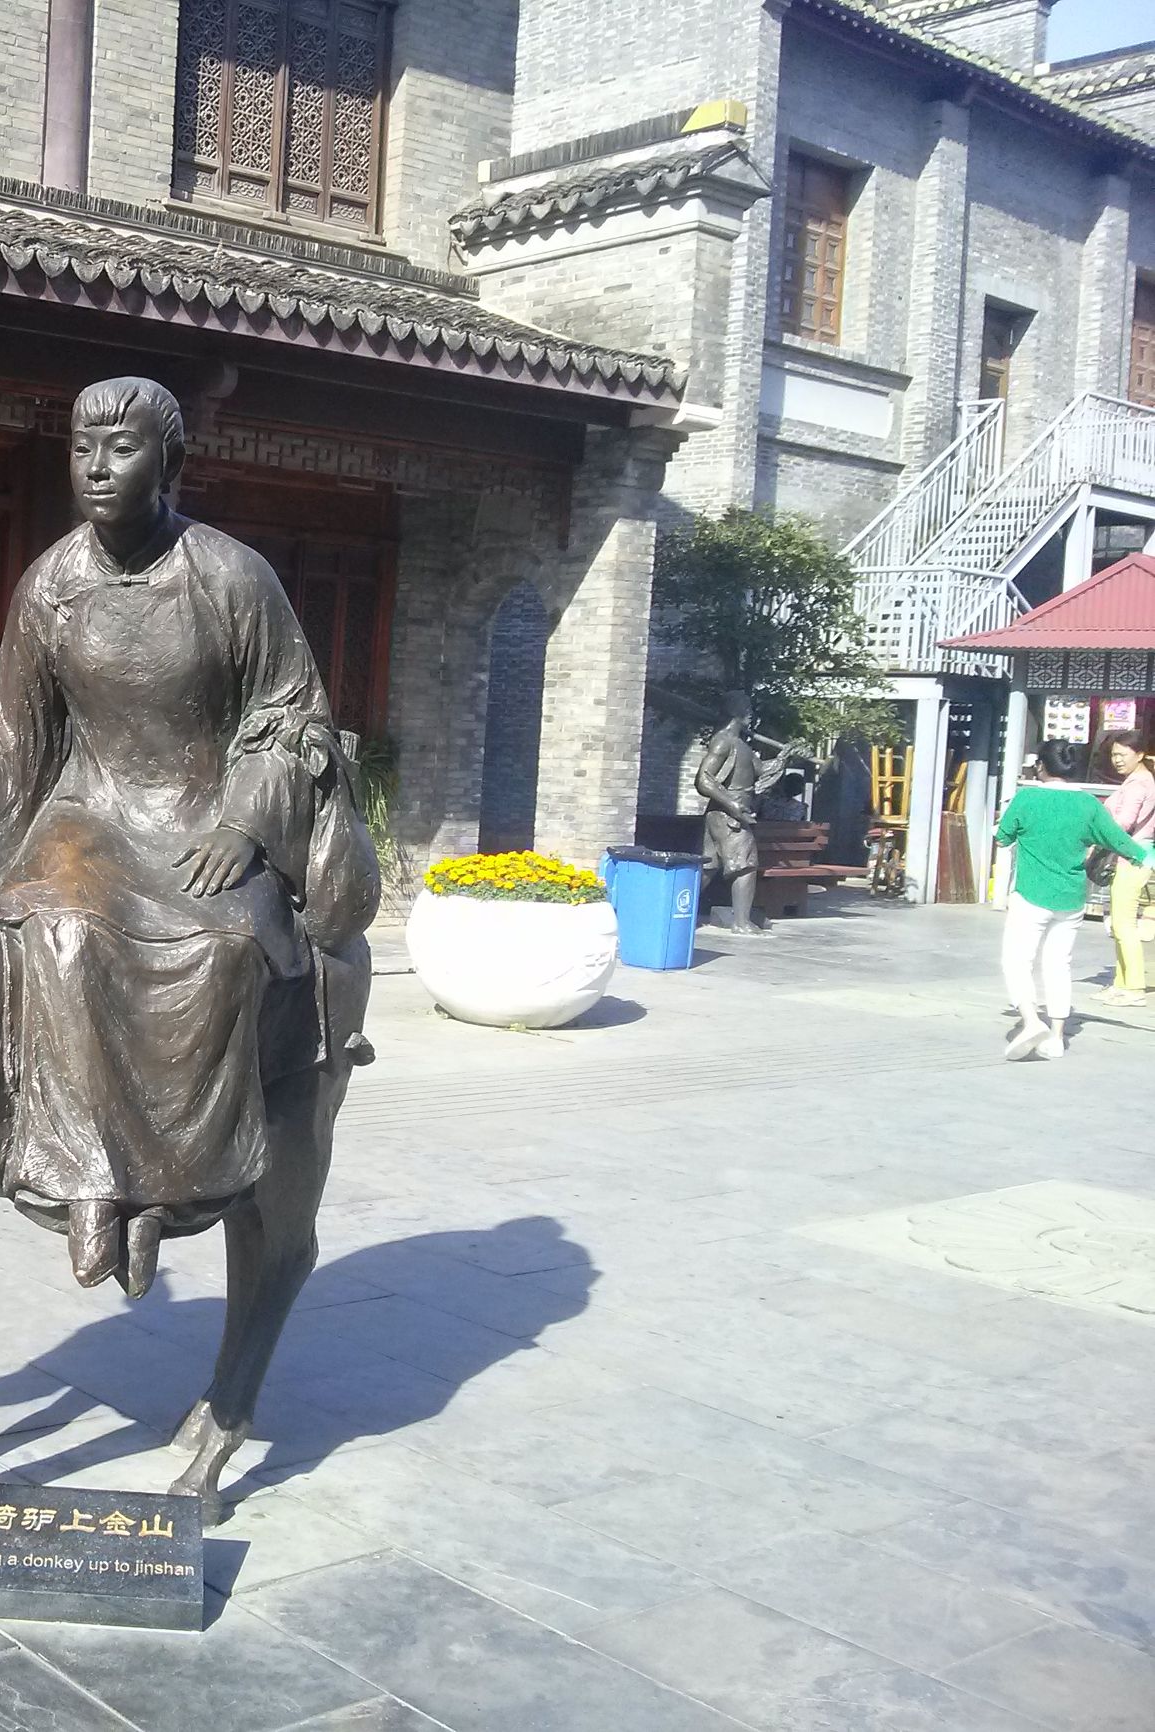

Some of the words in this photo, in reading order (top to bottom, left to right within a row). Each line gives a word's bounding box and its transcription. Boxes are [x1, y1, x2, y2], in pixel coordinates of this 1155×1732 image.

[7, 1554, 18, 1566] a
[23, 1553, 84, 1573] donkey
[89, 1560, 109, 1574] up
[114, 1560, 130, 1573] to
[134, 1560, 195, 1576] jinshan
